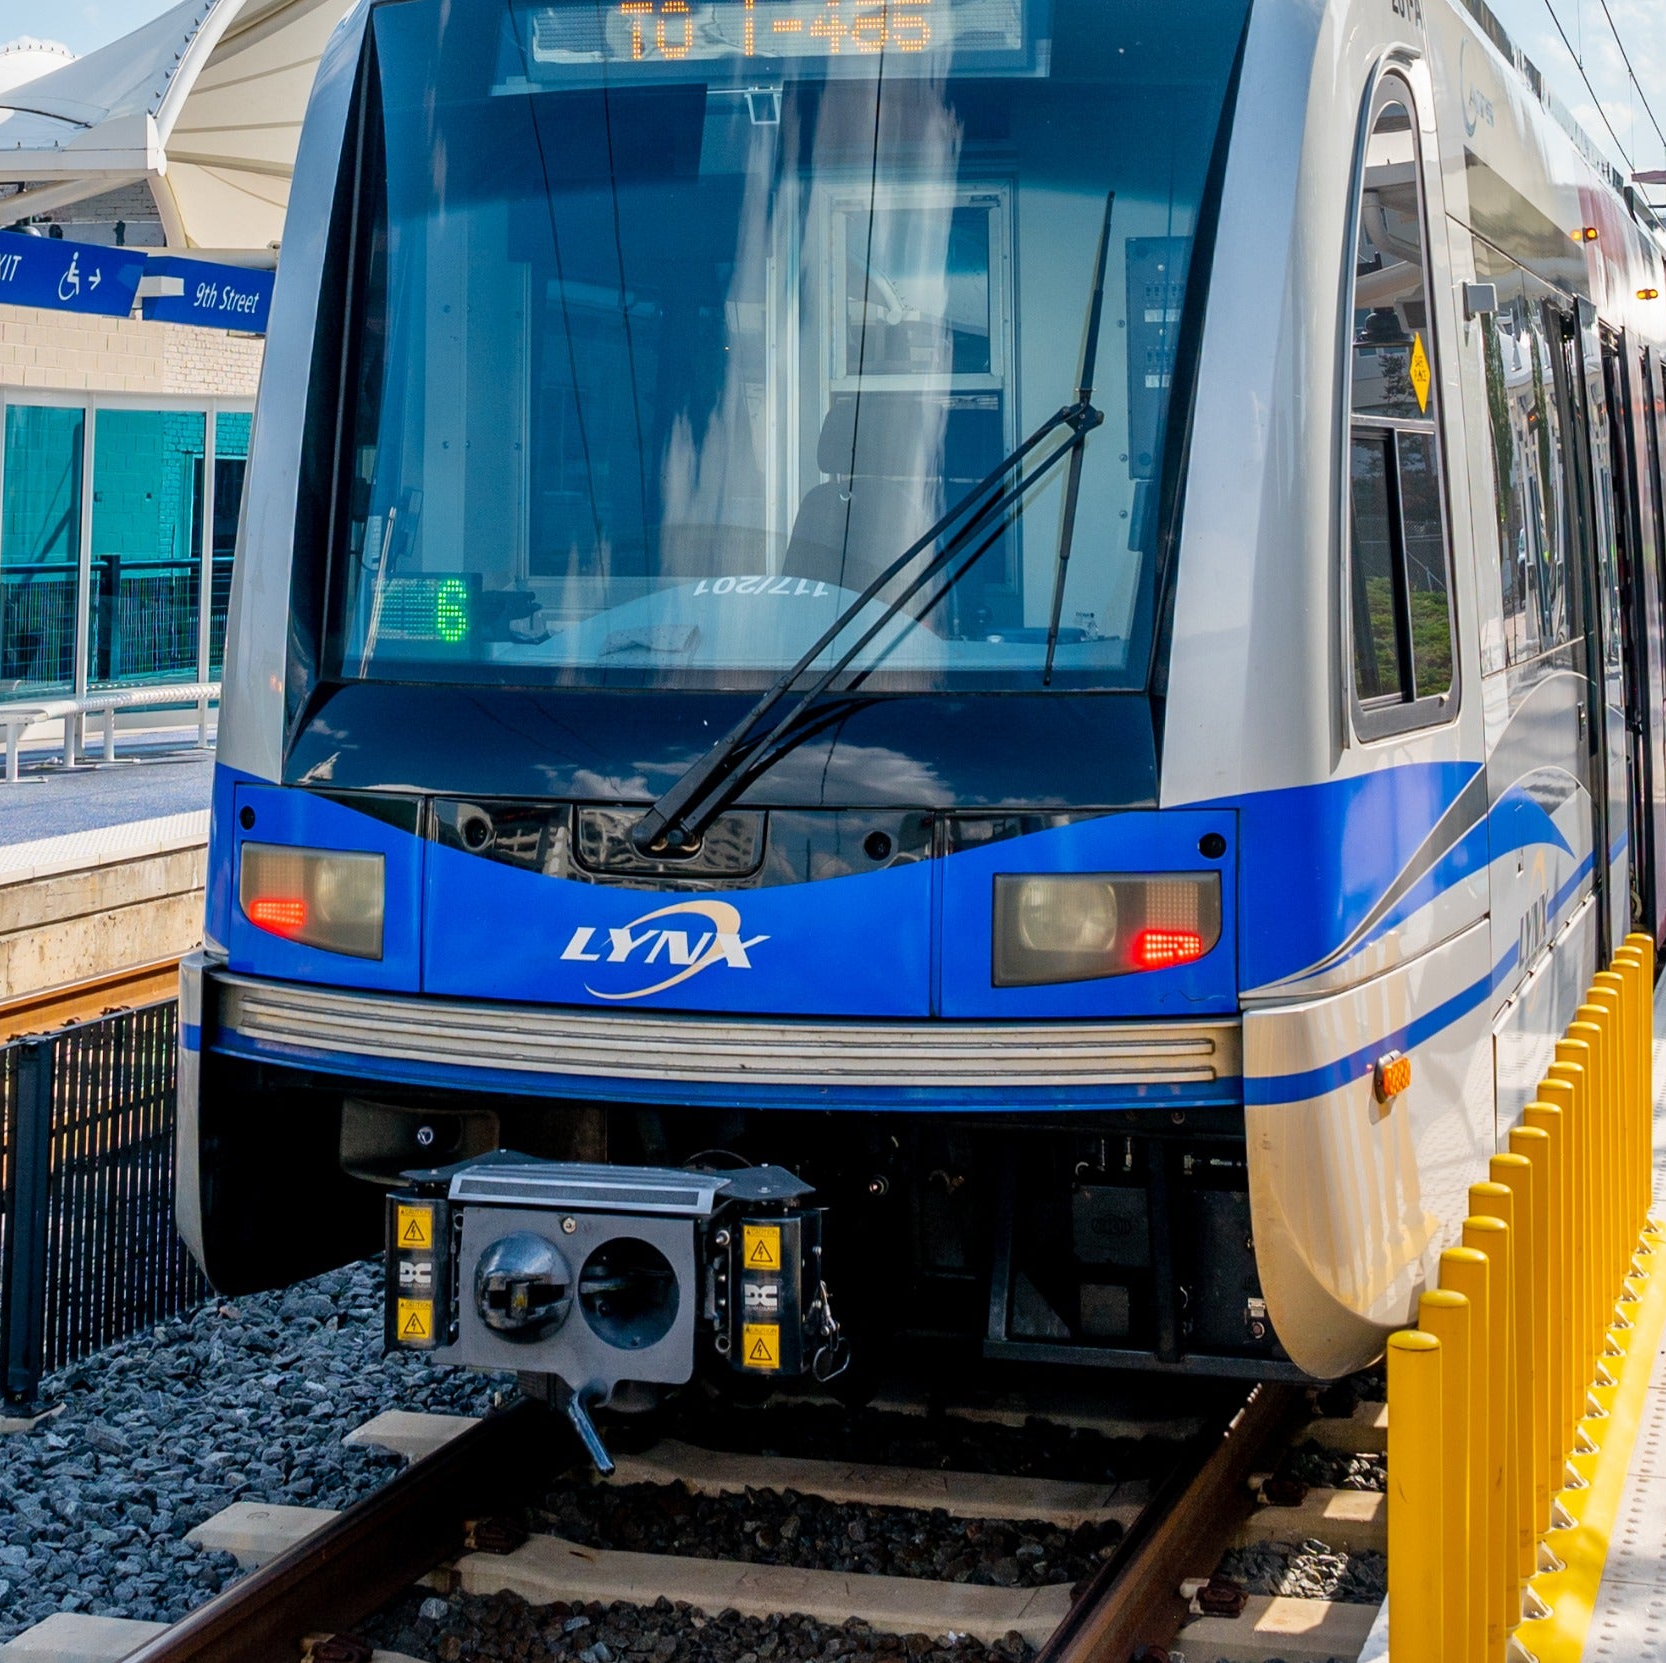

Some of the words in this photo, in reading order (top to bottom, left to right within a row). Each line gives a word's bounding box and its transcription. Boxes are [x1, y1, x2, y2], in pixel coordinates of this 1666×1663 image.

[621, 0, 693, 59] TO
[193, 282, 218, 308] 9th
[219, 285, 260, 314] Street
[693, 576, 829, 598] 117/201
[437, 579, 468, 642] 6
[559, 926, 772, 969] LYNX
